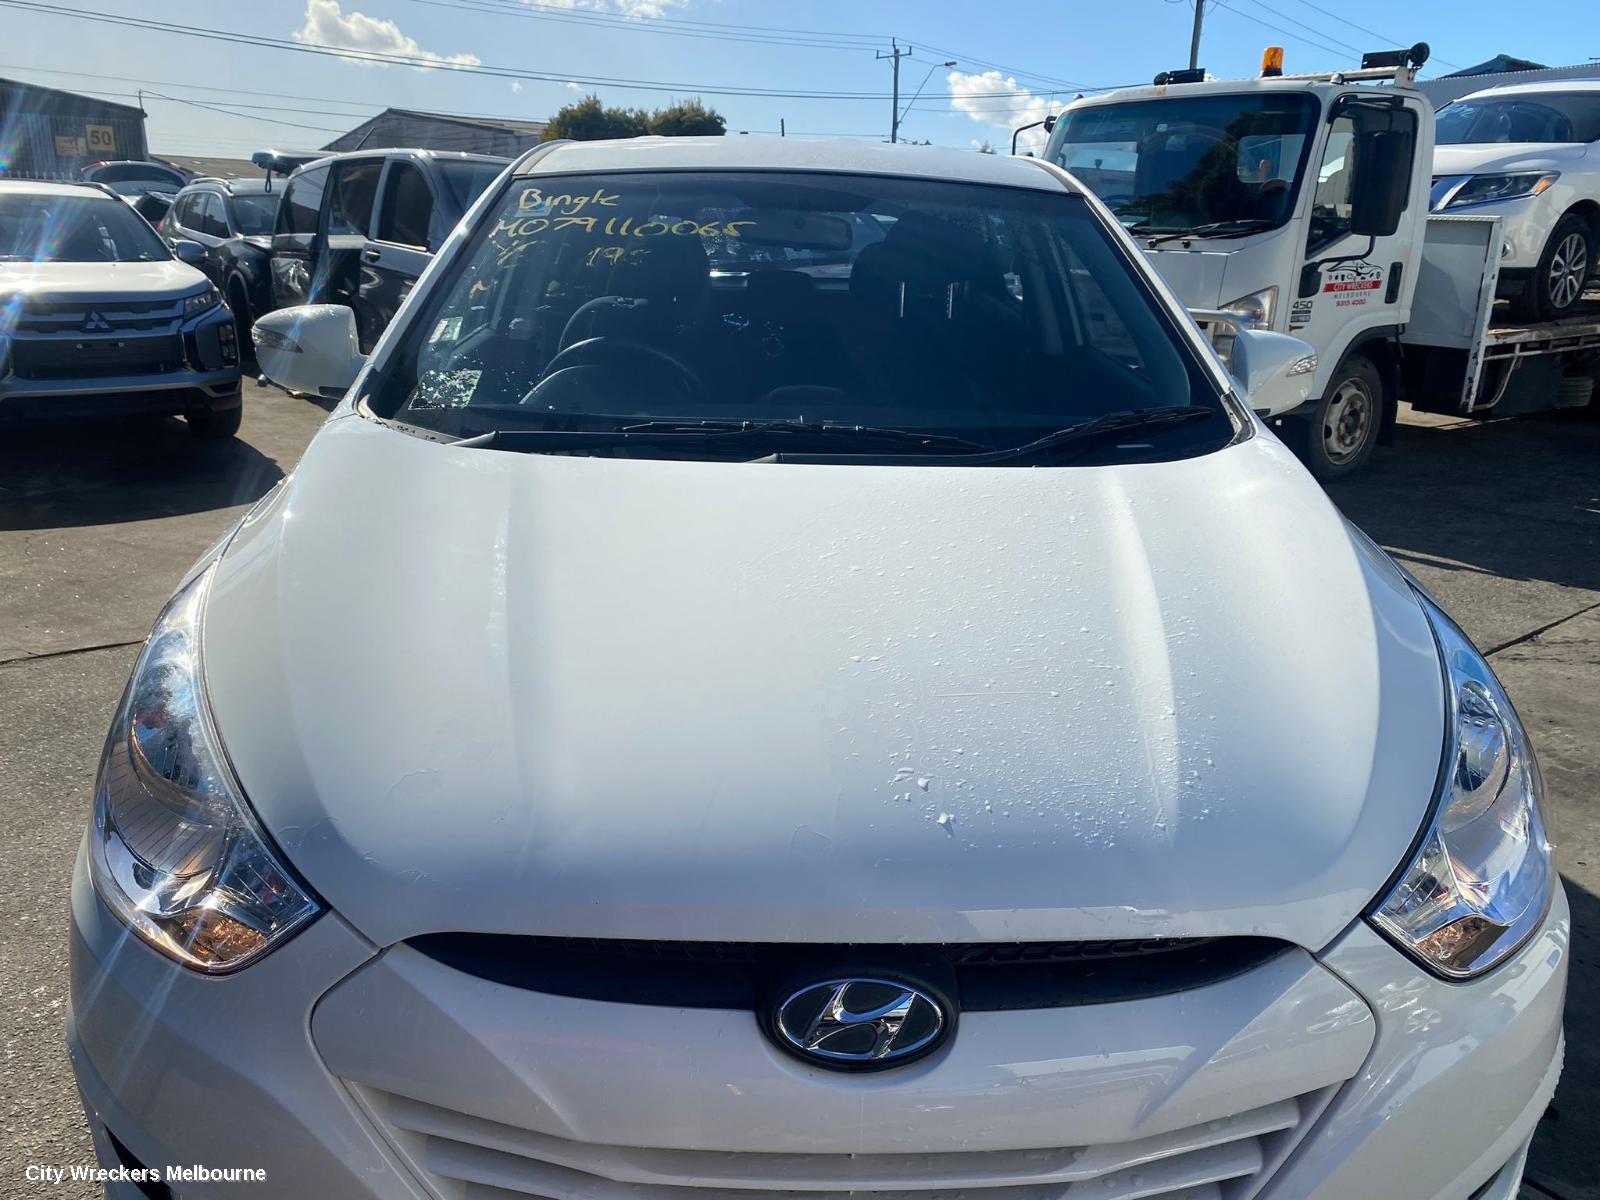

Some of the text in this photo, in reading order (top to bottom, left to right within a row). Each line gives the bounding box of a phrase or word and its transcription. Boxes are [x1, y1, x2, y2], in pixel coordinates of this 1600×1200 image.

[90, 130, 112, 145] 50
[1333, 281, 1374, 291] CITY WRECKERS
[1334, 291, 1371, 299] MELBOURNE
[1292, 300, 1313, 309] 450
